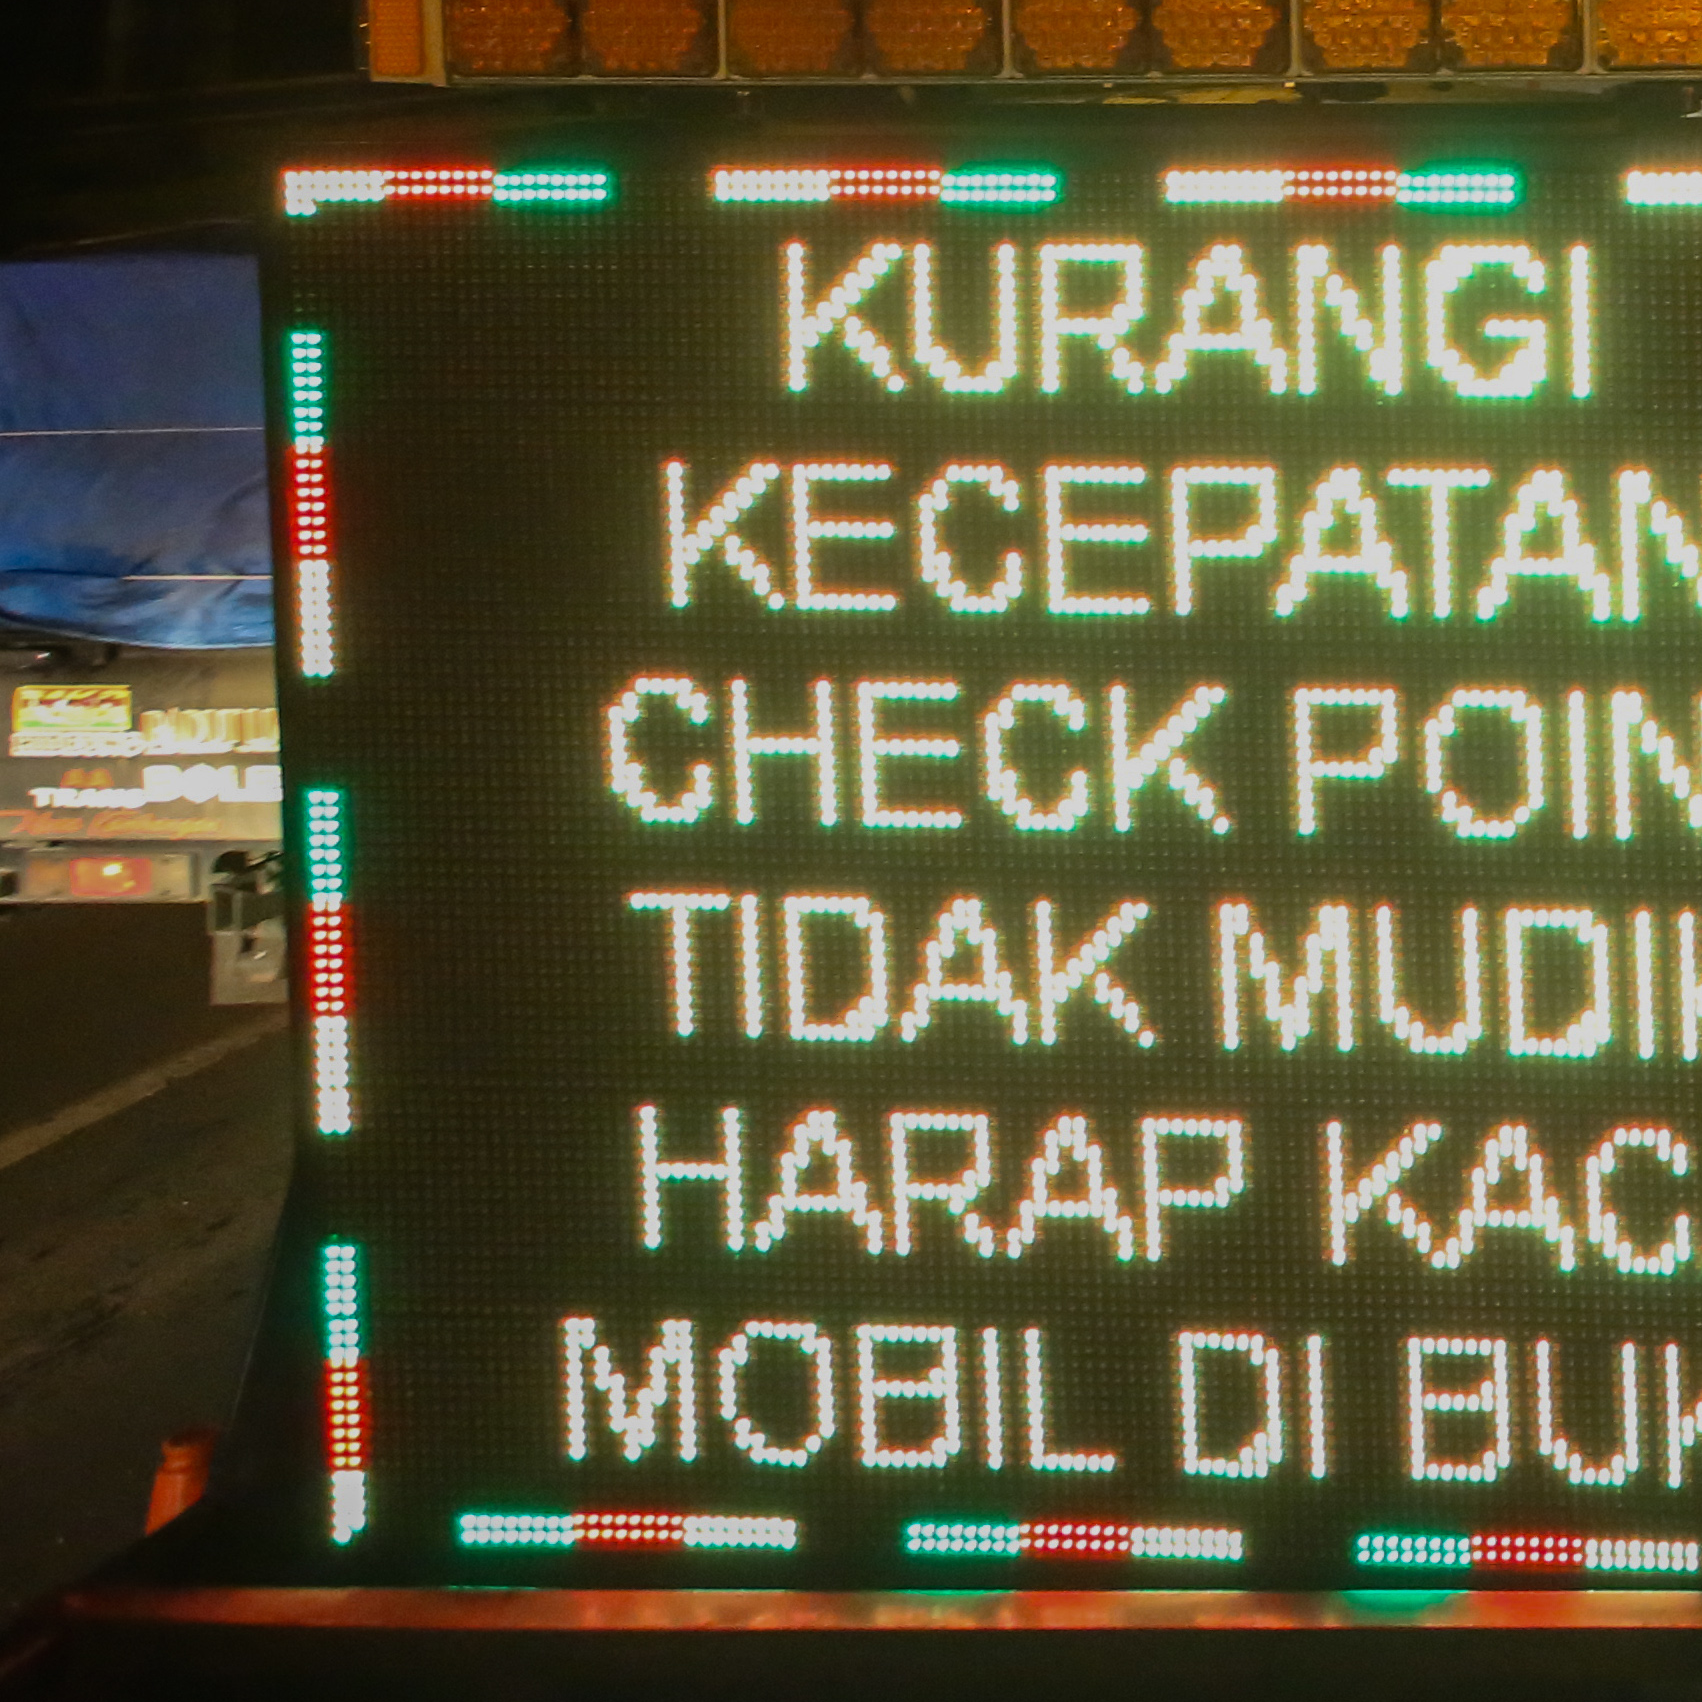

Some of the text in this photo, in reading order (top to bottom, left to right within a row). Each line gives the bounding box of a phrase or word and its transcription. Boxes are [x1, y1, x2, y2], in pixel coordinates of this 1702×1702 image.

[783, 239, 1595, 401] KURANGI
[604, 674, 1233, 837] CHECK
[626, 889, 1158, 1051] TIDAK
[636, 1102, 1248, 1264] HARAP
[561, 1314, 1119, 1474] MOBIL
[1175, 1328, 1329, 1481] DI
